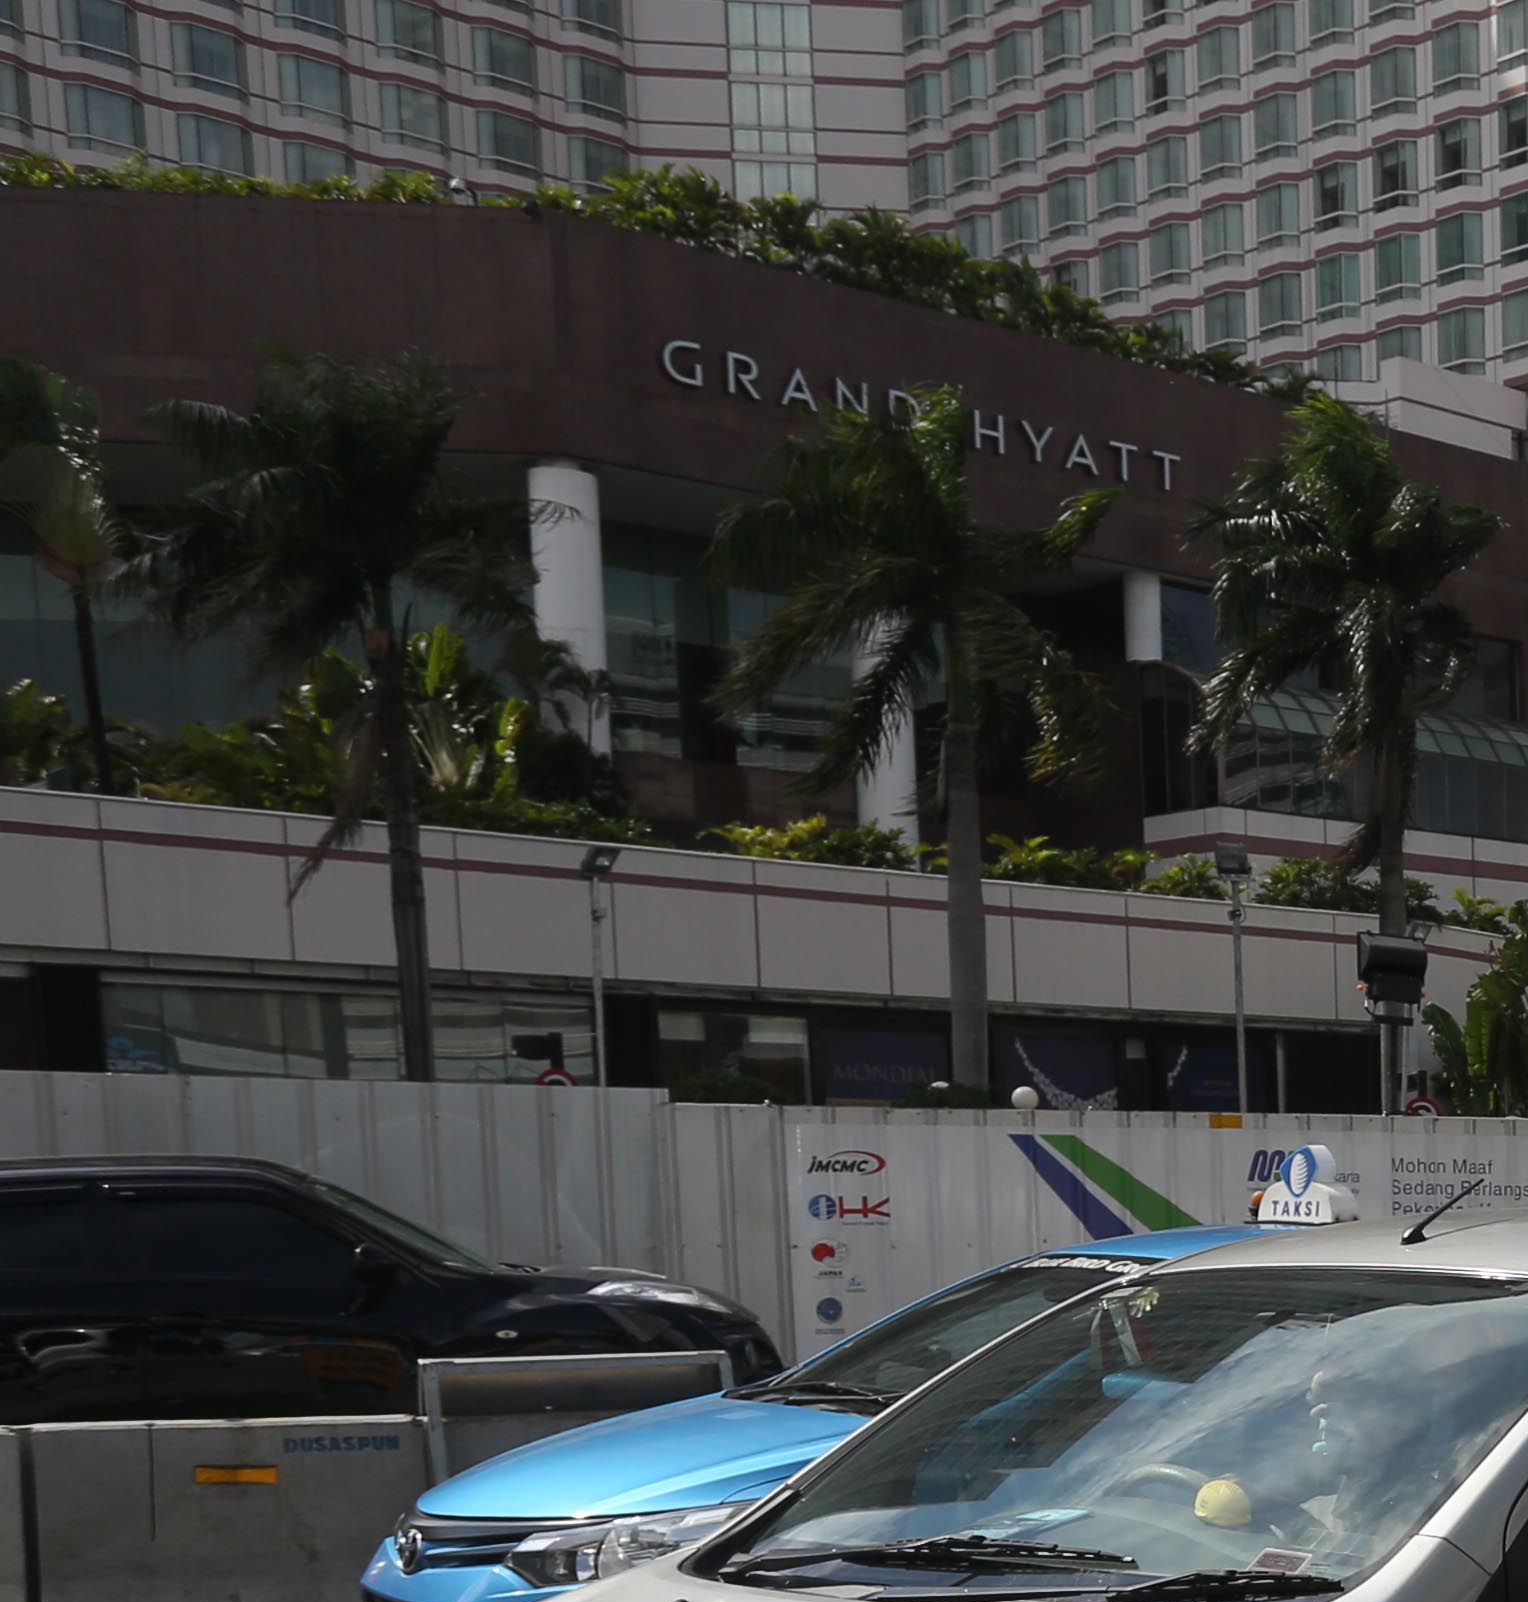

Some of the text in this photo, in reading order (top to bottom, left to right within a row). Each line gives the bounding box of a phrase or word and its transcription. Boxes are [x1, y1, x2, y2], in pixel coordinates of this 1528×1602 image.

[661, 338, 1182, 491] GRAND HYATT
[1452, 1158, 1494, 1175] Maaf
[1391, 1179, 1455, 1199] Sedang
[1271, 1200, 1320, 1217] TAKSI
